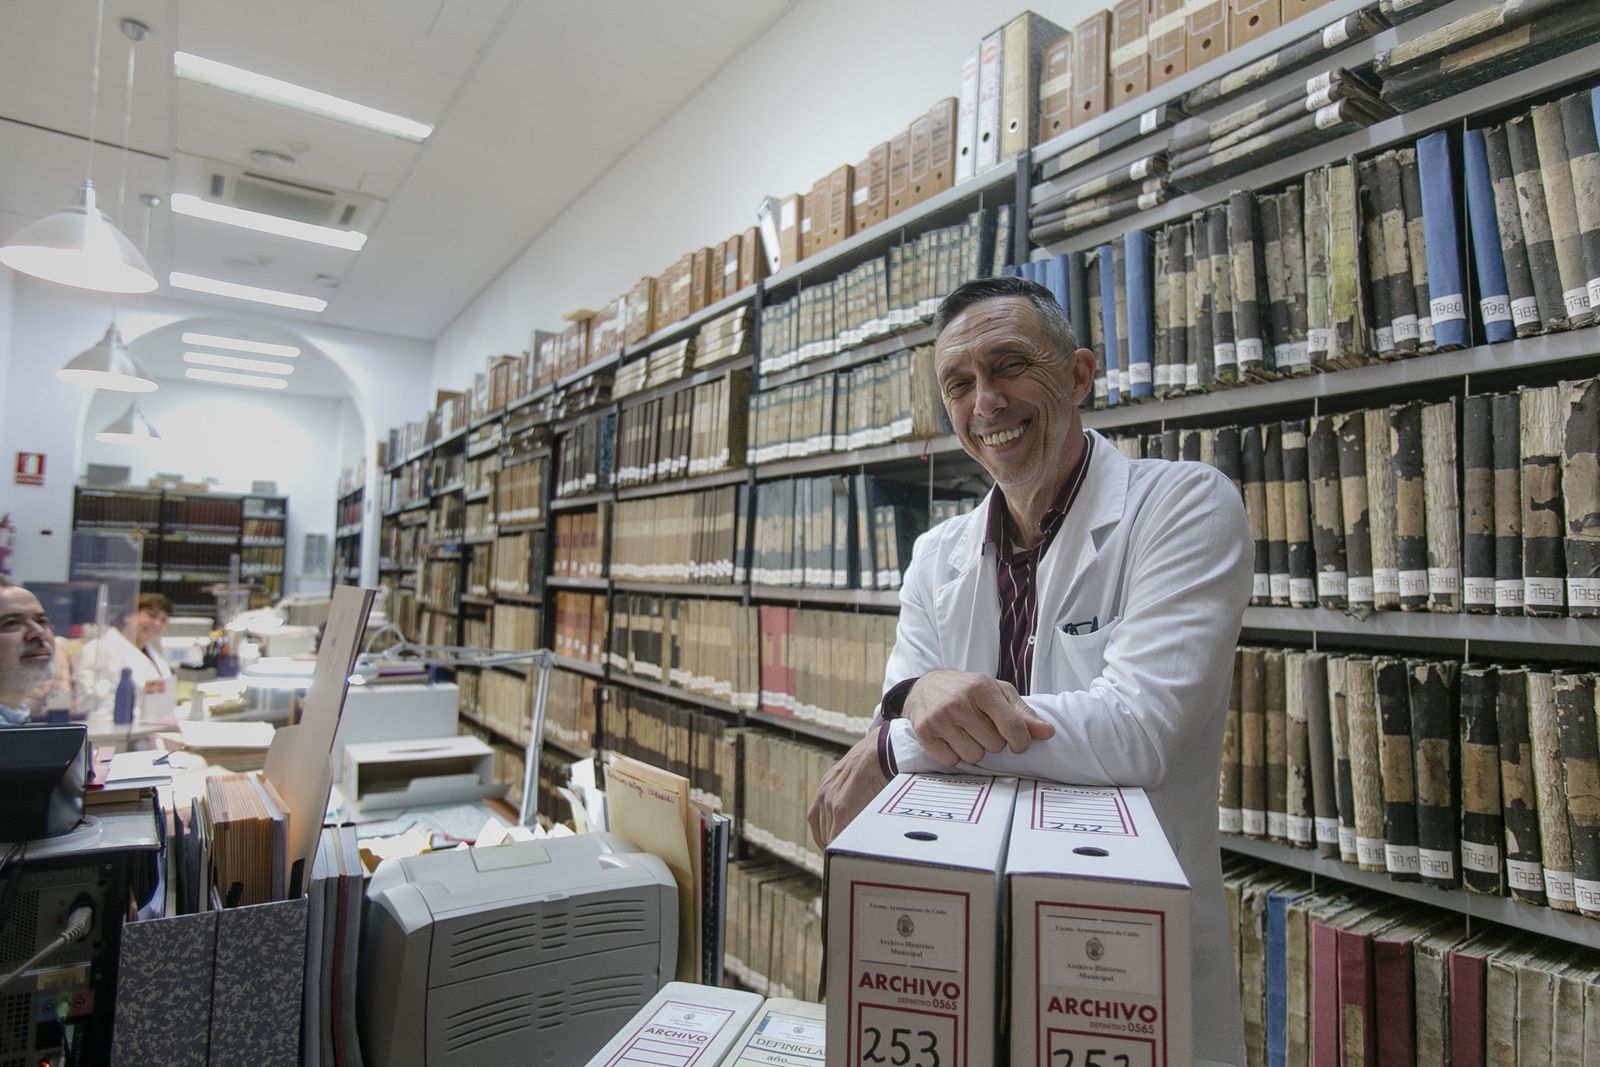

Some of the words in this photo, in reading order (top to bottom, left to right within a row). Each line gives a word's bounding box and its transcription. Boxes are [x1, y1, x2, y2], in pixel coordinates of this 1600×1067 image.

[1434, 302, 1462, 316] 1980
[1468, 586, 1494, 599] 1949
[1498, 588, 1524, 601] 1950
[898, 807, 954, 820] 253
[1049, 822, 1110, 833] 252
[1423, 859, 1449, 873] 1920
[879, 939, 904, 947] Archivo
[890, 948, 923, 958] Municipal
[1066, 963, 1093, 971] Archivo
[1079, 972, 1114, 982] Municipal
[858, 972, 961, 1000] ARCHIVO
[897, 996, 931, 1007] DEFINITIVO
[932, 998, 958, 1011] 0565
[1047, 996, 1157, 1023] ARCHIVO
[645, 1027, 708, 1042] ARCHIVO
[1127, 1022, 1155, 1035] 0565
[756, 1038, 825, 1056] DEFINICLA
[863, 1027, 940, 1067] 253
